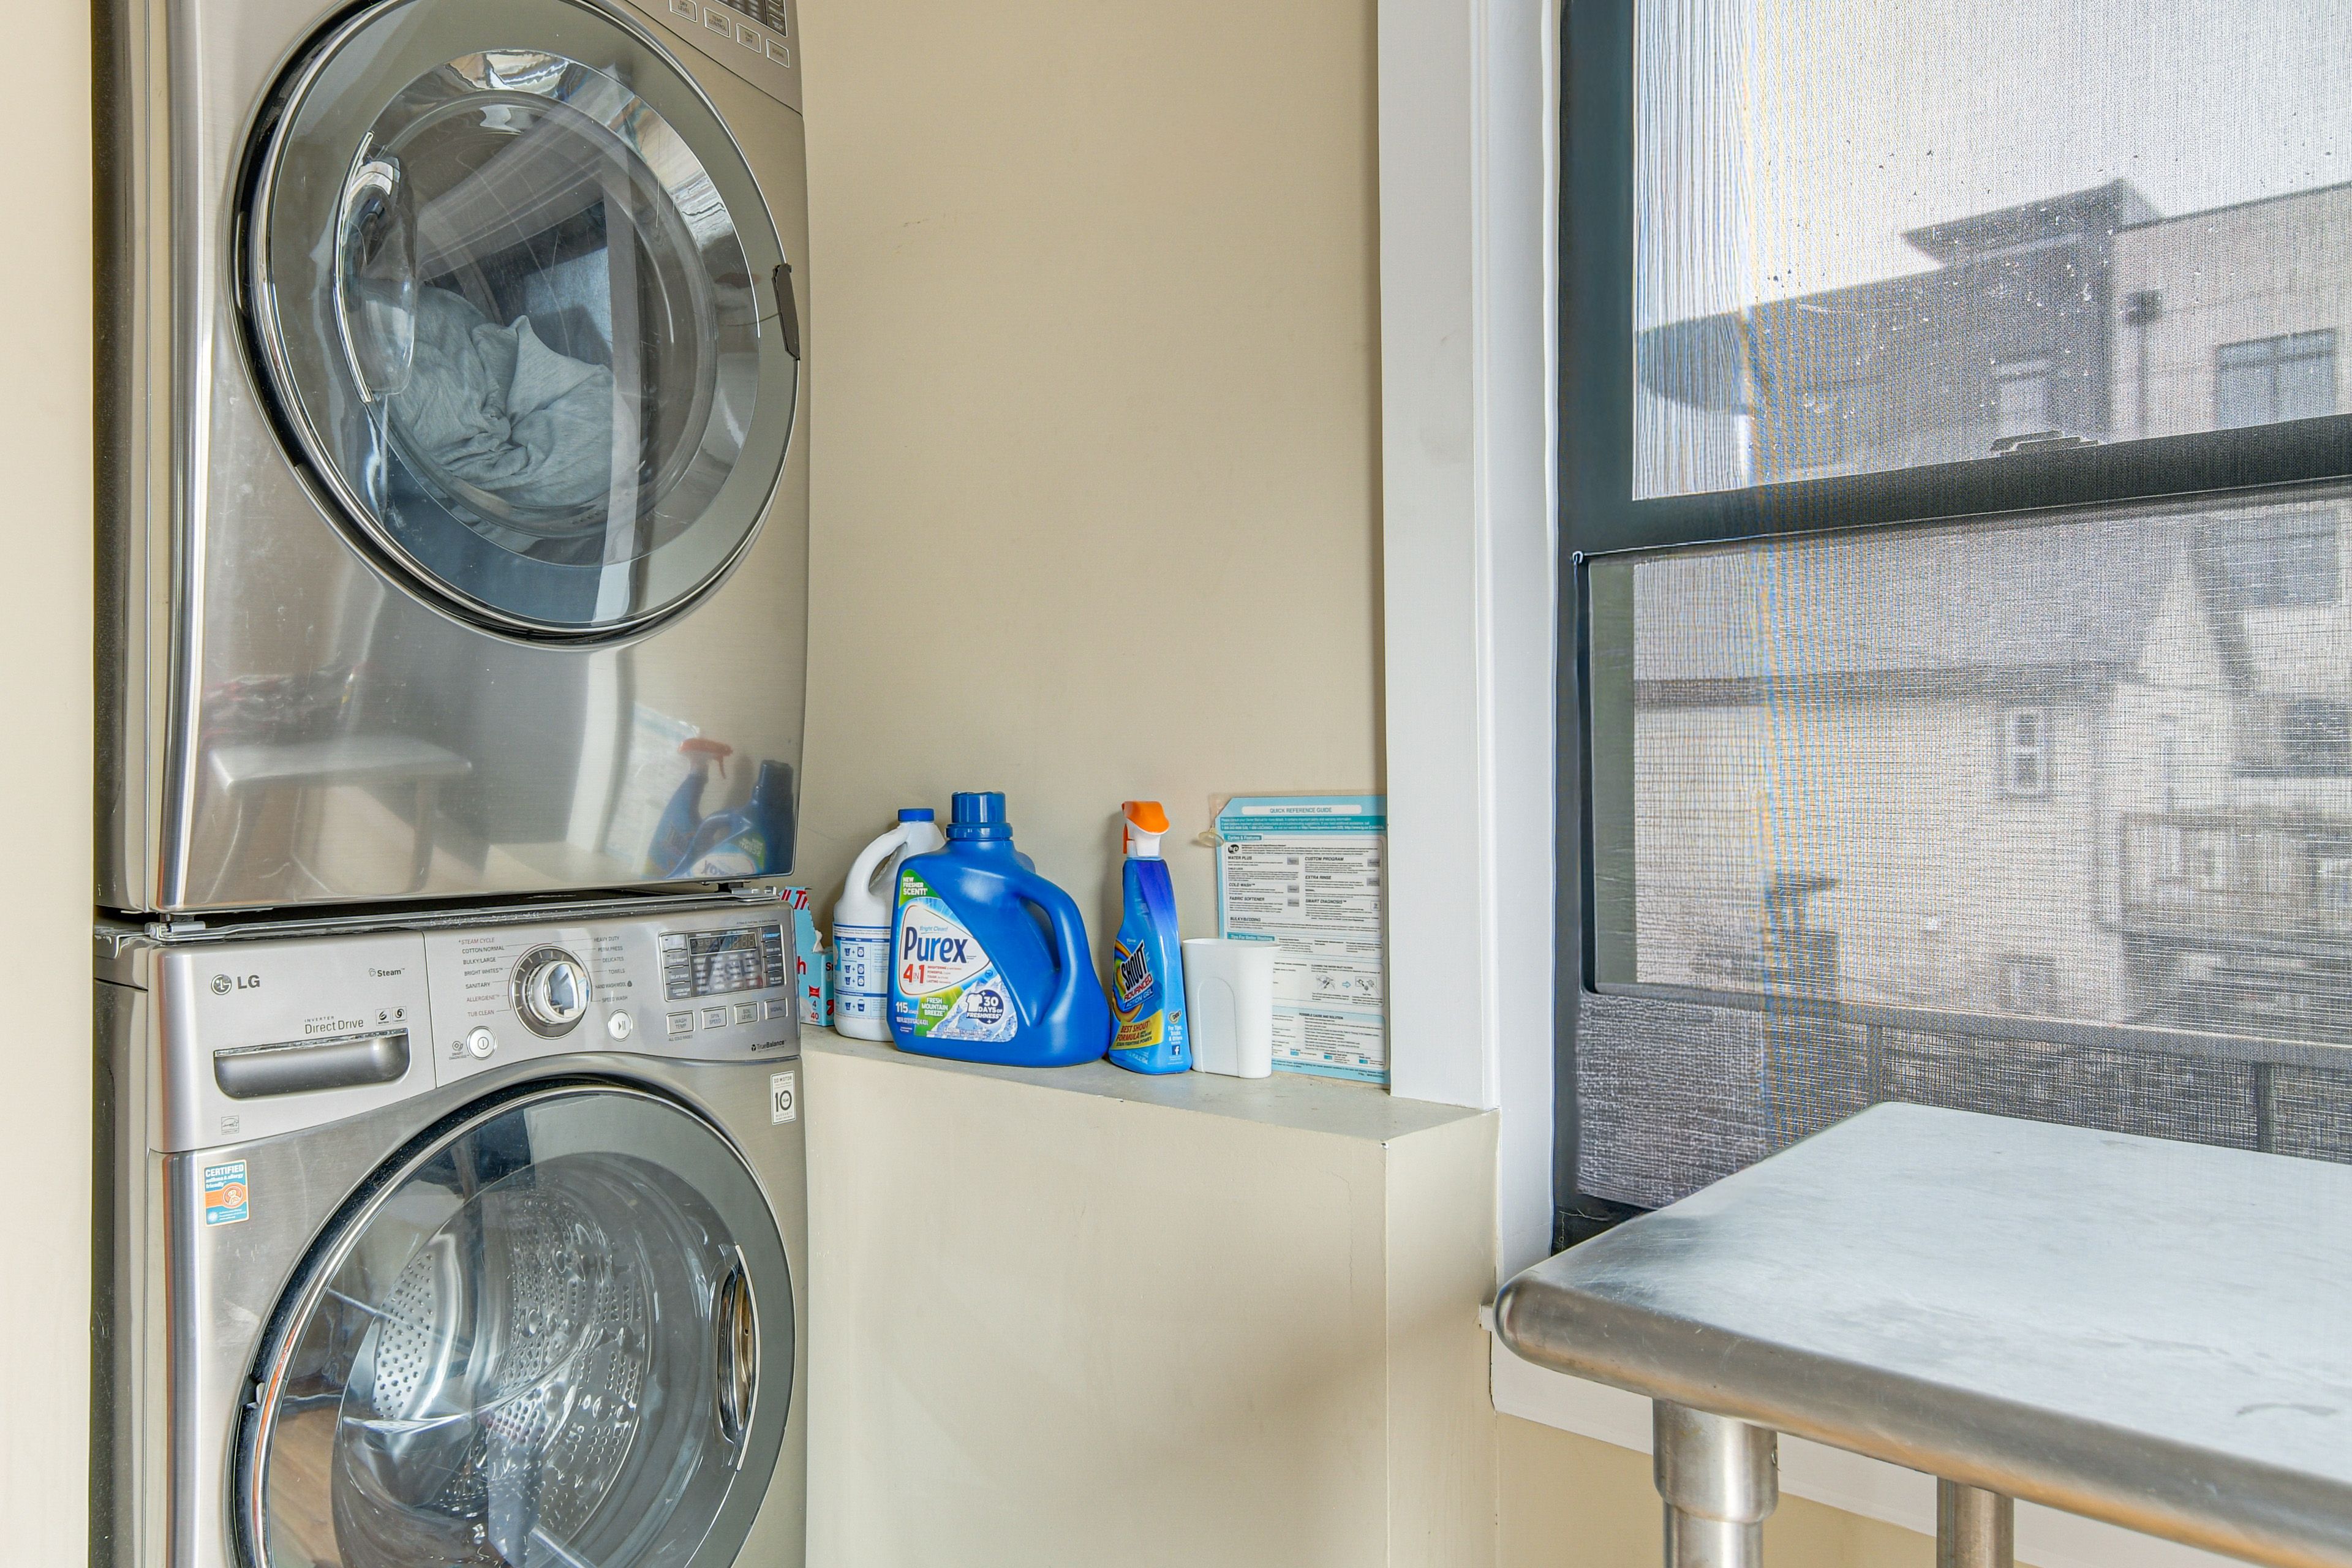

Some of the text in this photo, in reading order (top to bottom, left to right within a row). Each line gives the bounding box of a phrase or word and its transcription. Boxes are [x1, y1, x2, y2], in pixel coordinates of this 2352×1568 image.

[678, 5, 690, 14] LEVEL
[709, 19, 727, 31] CONTROL
[903, 927, 968, 963] Purex
[1121, 941, 1148, 991] SHOUT
[237, 975, 260, 989] LG
[1124, 973, 1153, 1001] ADVANCED
[984, 997, 999, 1006] 30
[1126, 989, 1153, 1008] ACTION GEL
[895, 1001, 908, 1013] 115
[305, 1019, 364, 1035] Direct Drive
[1133, 1020, 1149, 1033] SHOUT
[756, 1040, 785, 1049] TrueBalance
[775, 1090, 792, 1112] 10
[205, 1164, 244, 1177] CERTIFIED
